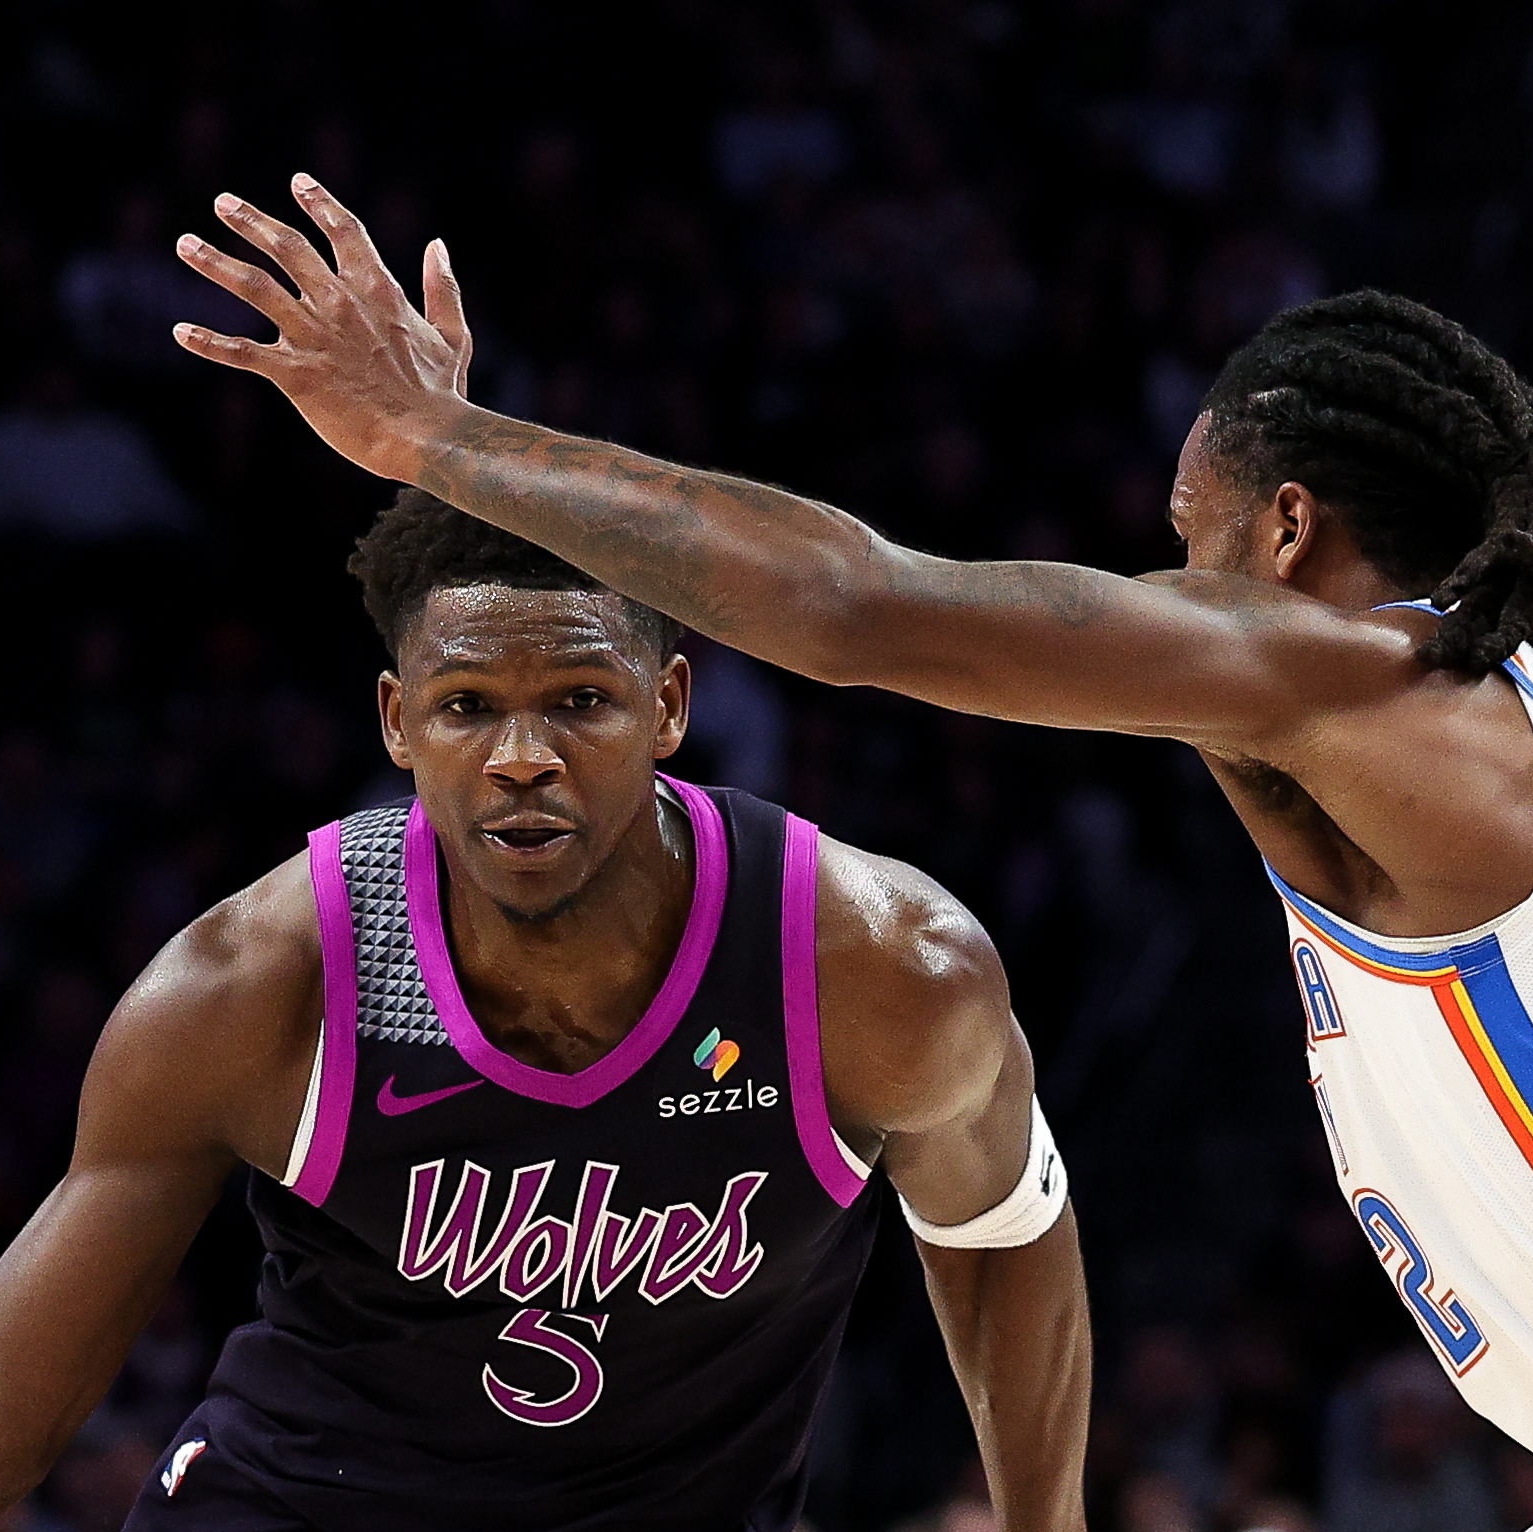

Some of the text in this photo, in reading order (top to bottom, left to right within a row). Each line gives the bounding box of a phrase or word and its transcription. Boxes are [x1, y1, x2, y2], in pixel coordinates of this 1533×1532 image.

[657, 1078, 779, 1119] sezzle
[397, 1158, 769, 1309] Wolves
[481, 1308, 610, 1428] 5
